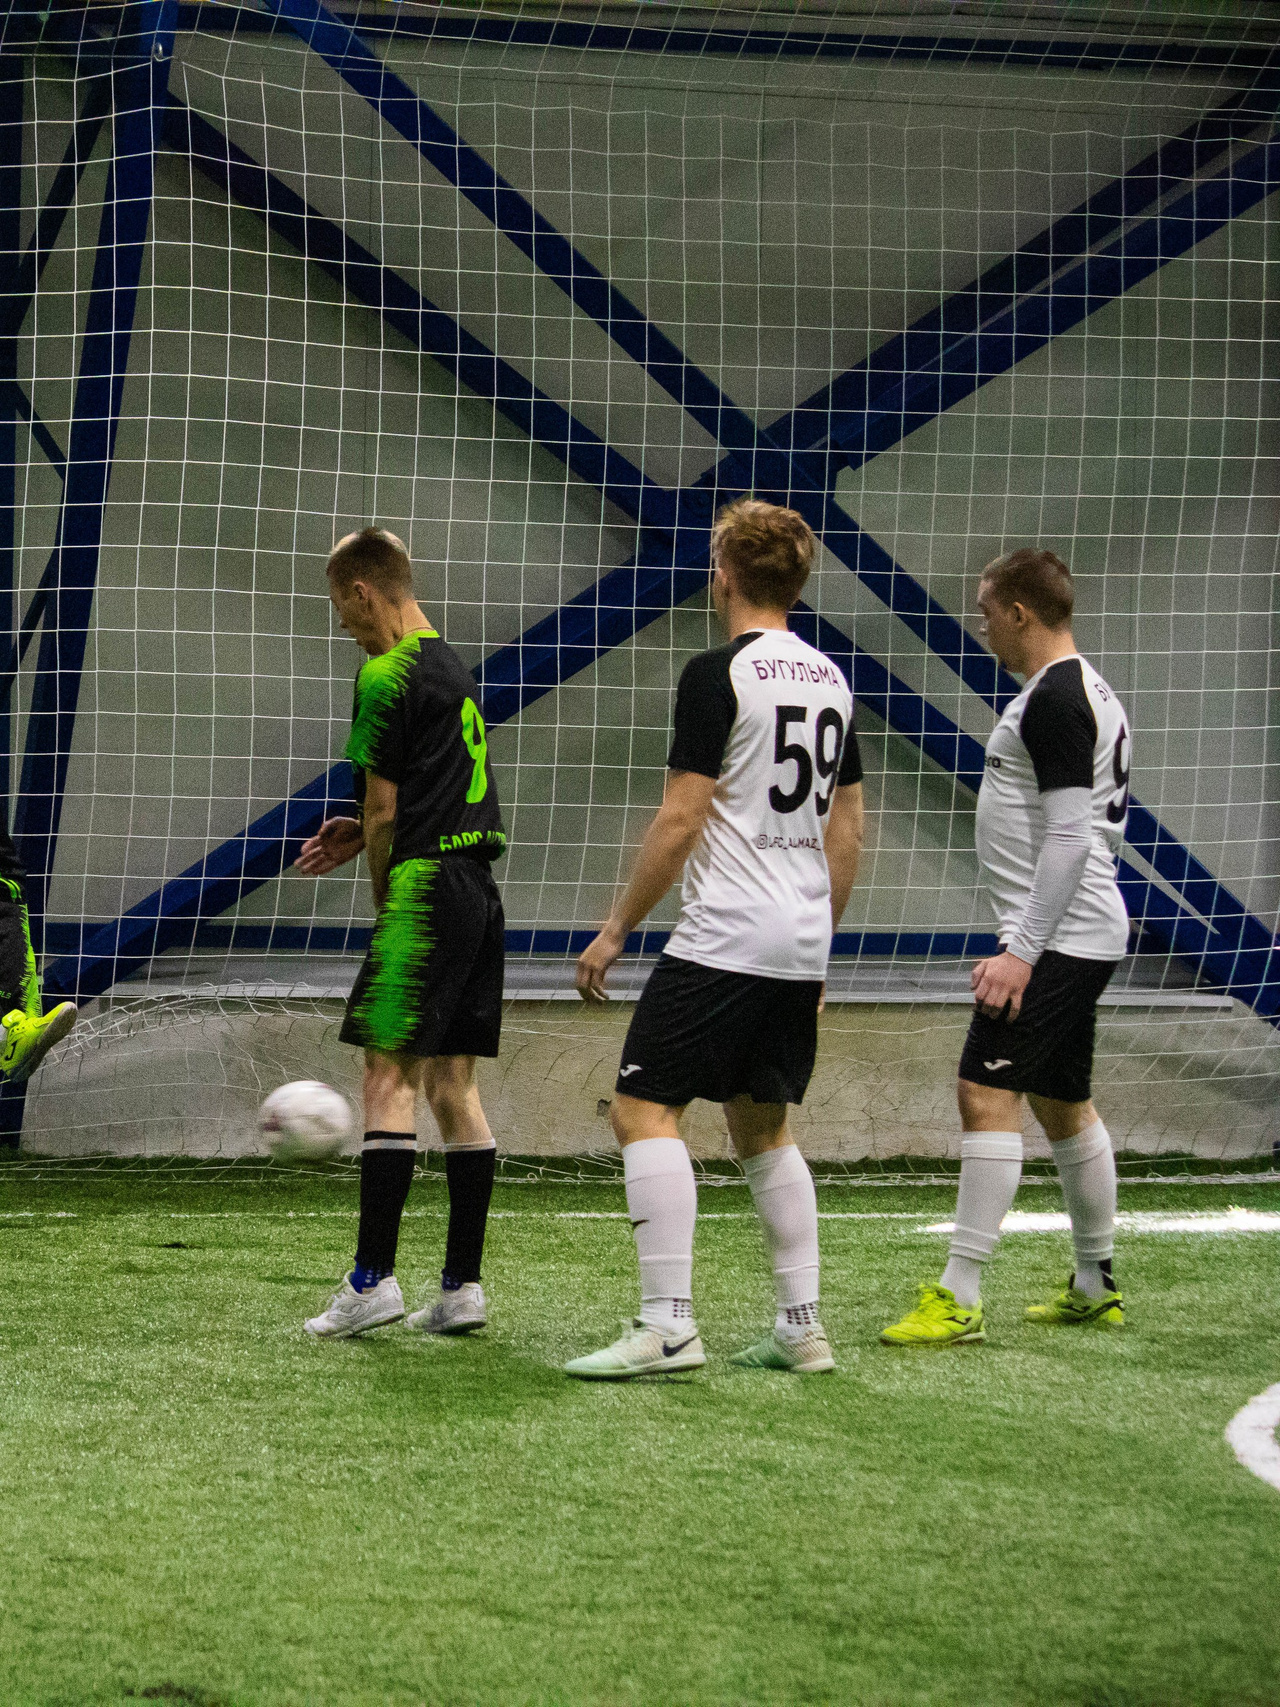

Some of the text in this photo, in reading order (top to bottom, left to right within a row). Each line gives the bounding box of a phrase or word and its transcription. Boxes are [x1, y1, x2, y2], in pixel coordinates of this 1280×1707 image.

[751, 658, 840, 688] БУГУЛЬМА
[460, 696, 488, 804] 9
[768, 705, 844, 817] 59
